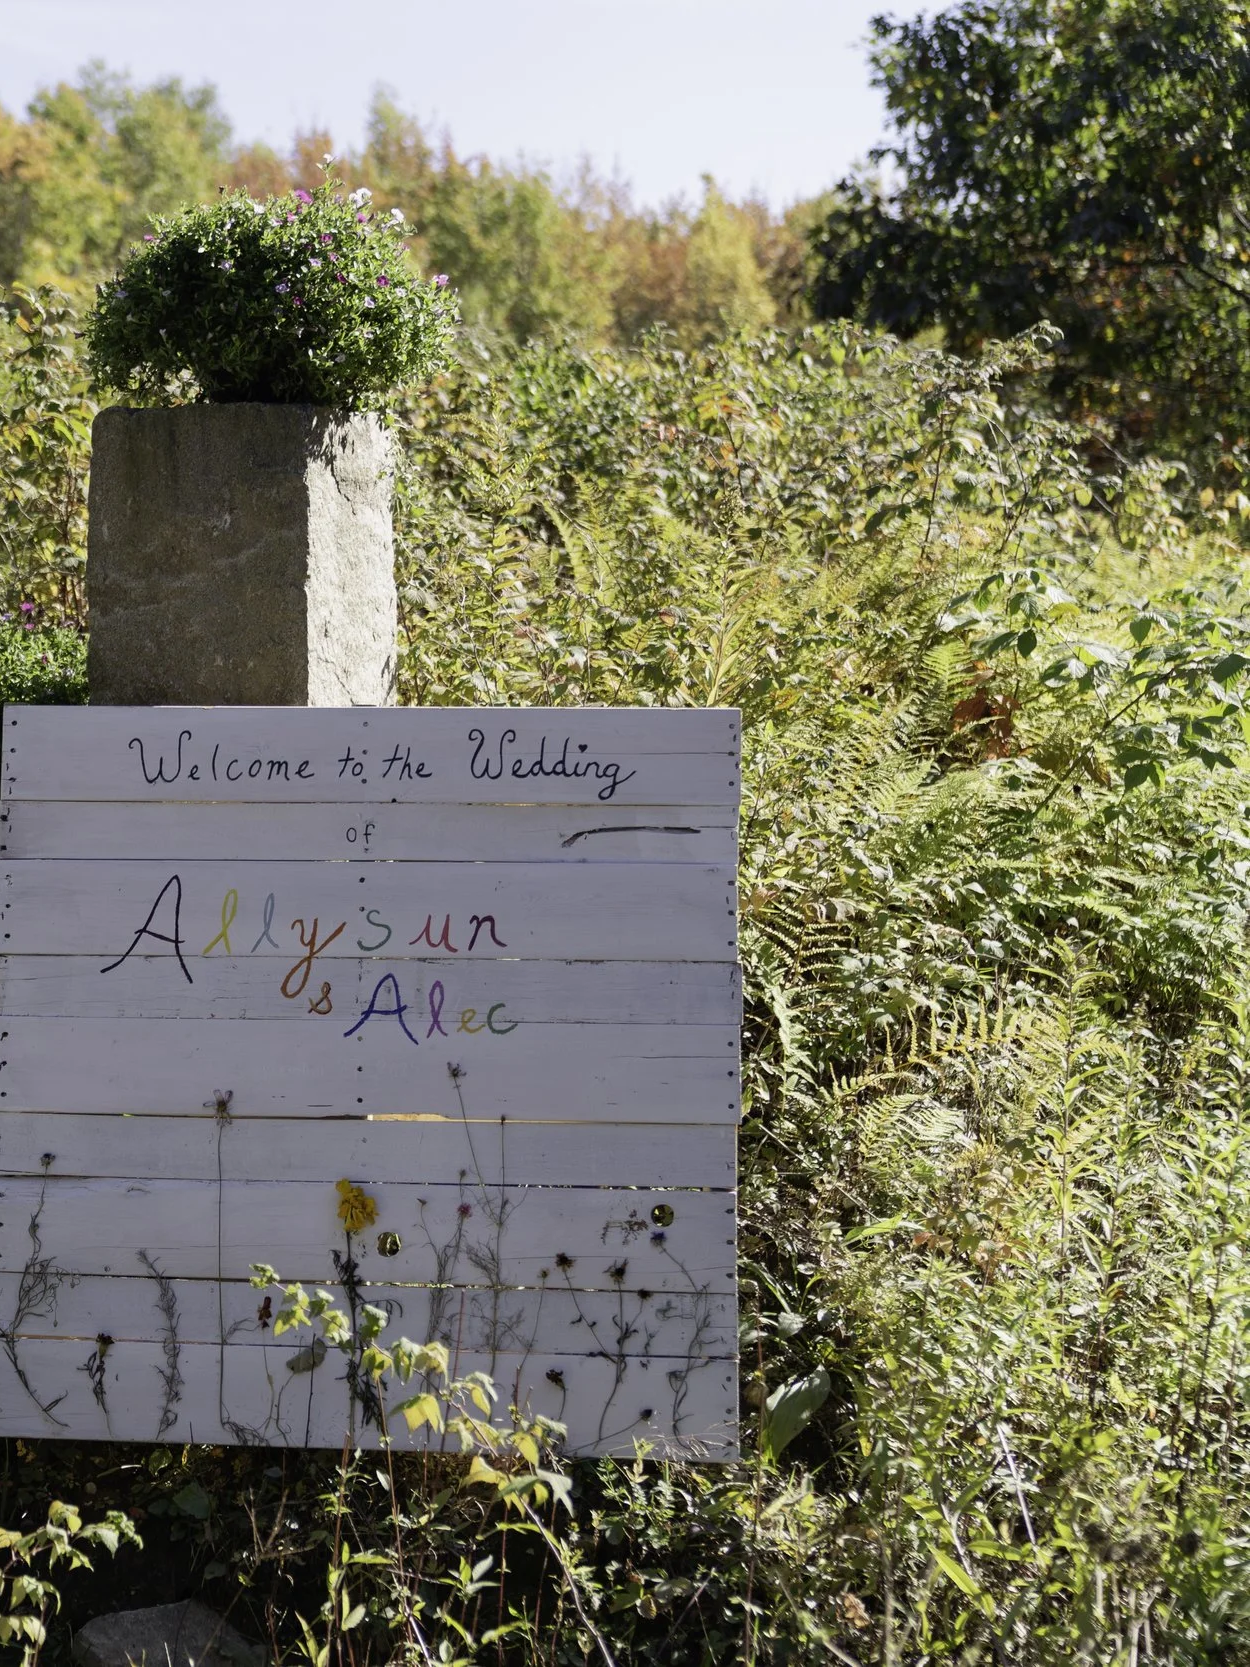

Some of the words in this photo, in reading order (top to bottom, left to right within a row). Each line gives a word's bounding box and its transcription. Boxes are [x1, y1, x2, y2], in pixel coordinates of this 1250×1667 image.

[127, 729, 316, 785] Welcome
[336, 744, 365, 780] to
[381, 743, 433, 781] the
[467, 728, 637, 800] Wedding
[345, 823, 377, 844] of
[100, 874, 508, 999] Allysun
[343, 972, 519, 1046] Alec
